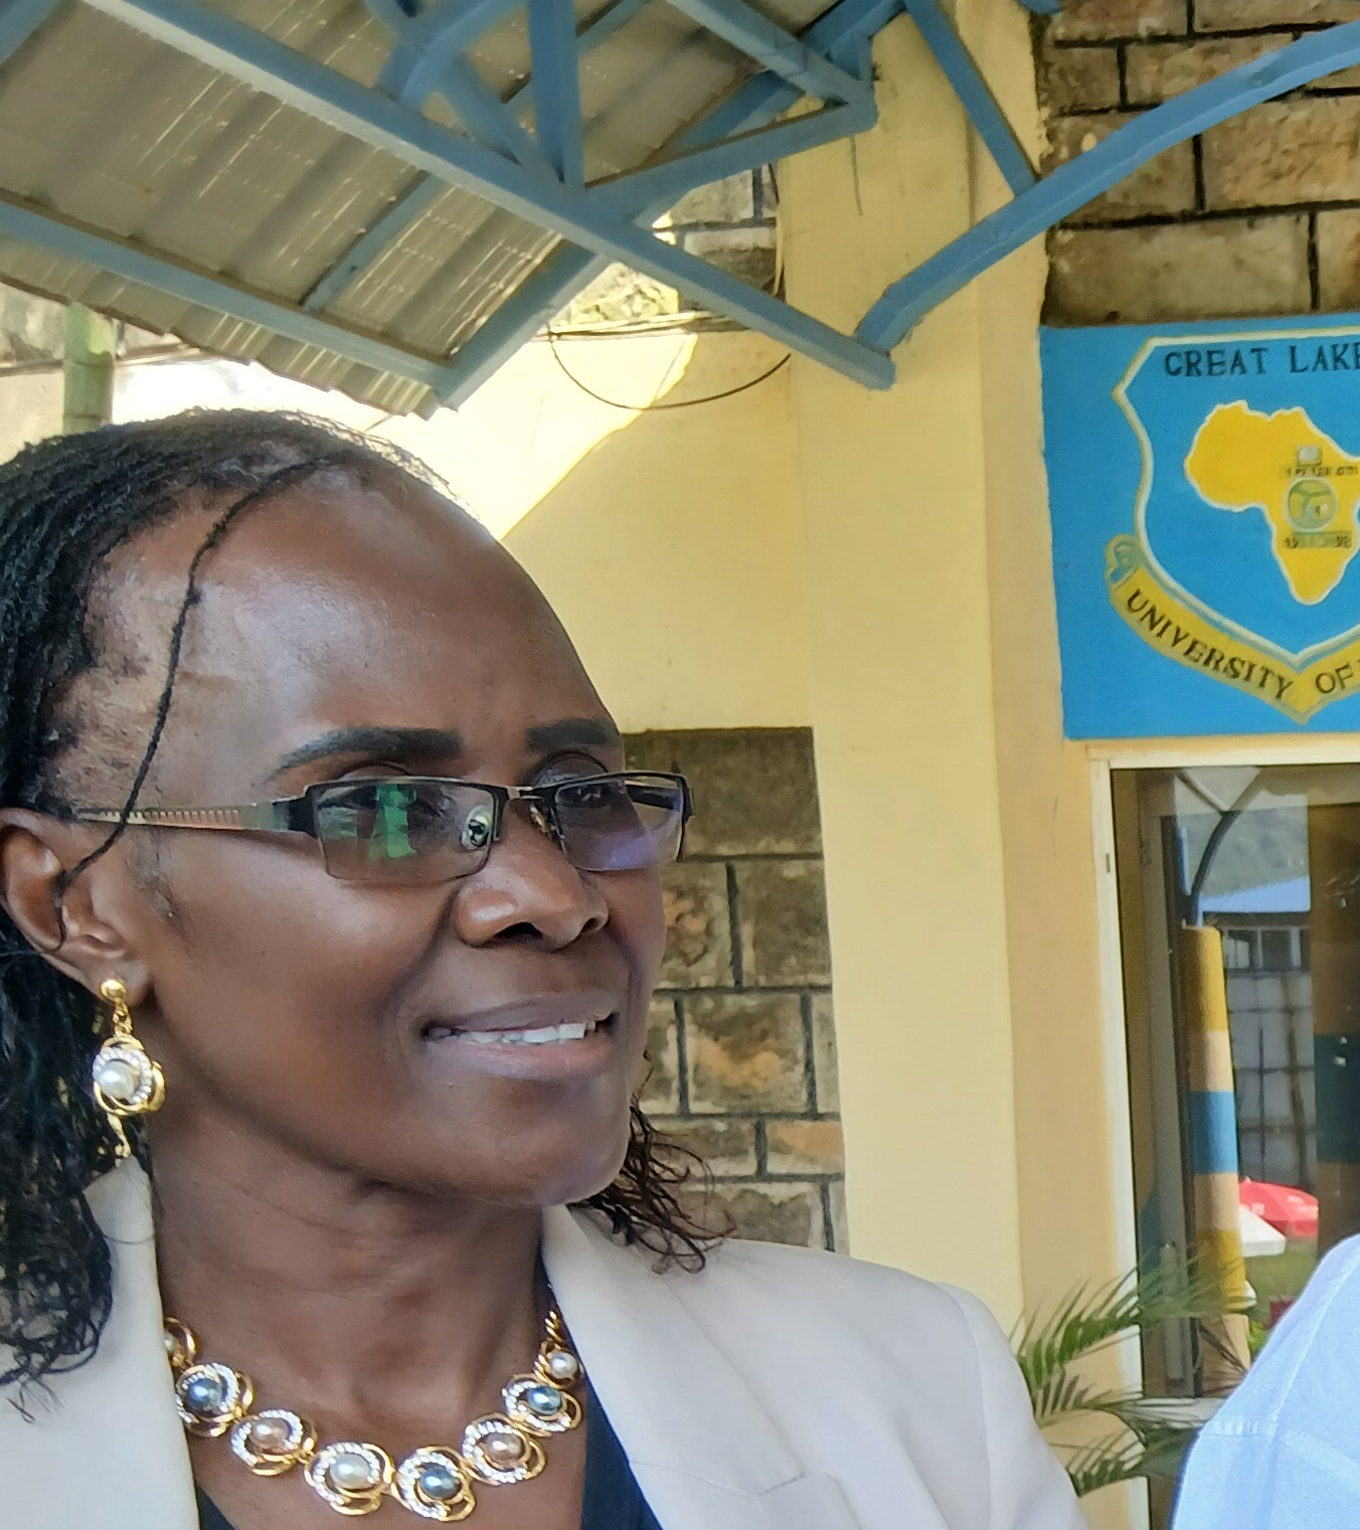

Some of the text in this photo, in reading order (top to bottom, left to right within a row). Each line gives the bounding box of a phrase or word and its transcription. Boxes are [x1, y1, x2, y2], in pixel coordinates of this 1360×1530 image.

[1163, 347, 1269, 377] GREAT
[1127, 588, 1294, 700] UNIVERSITY
[1314, 663, 1354, 695] OF
